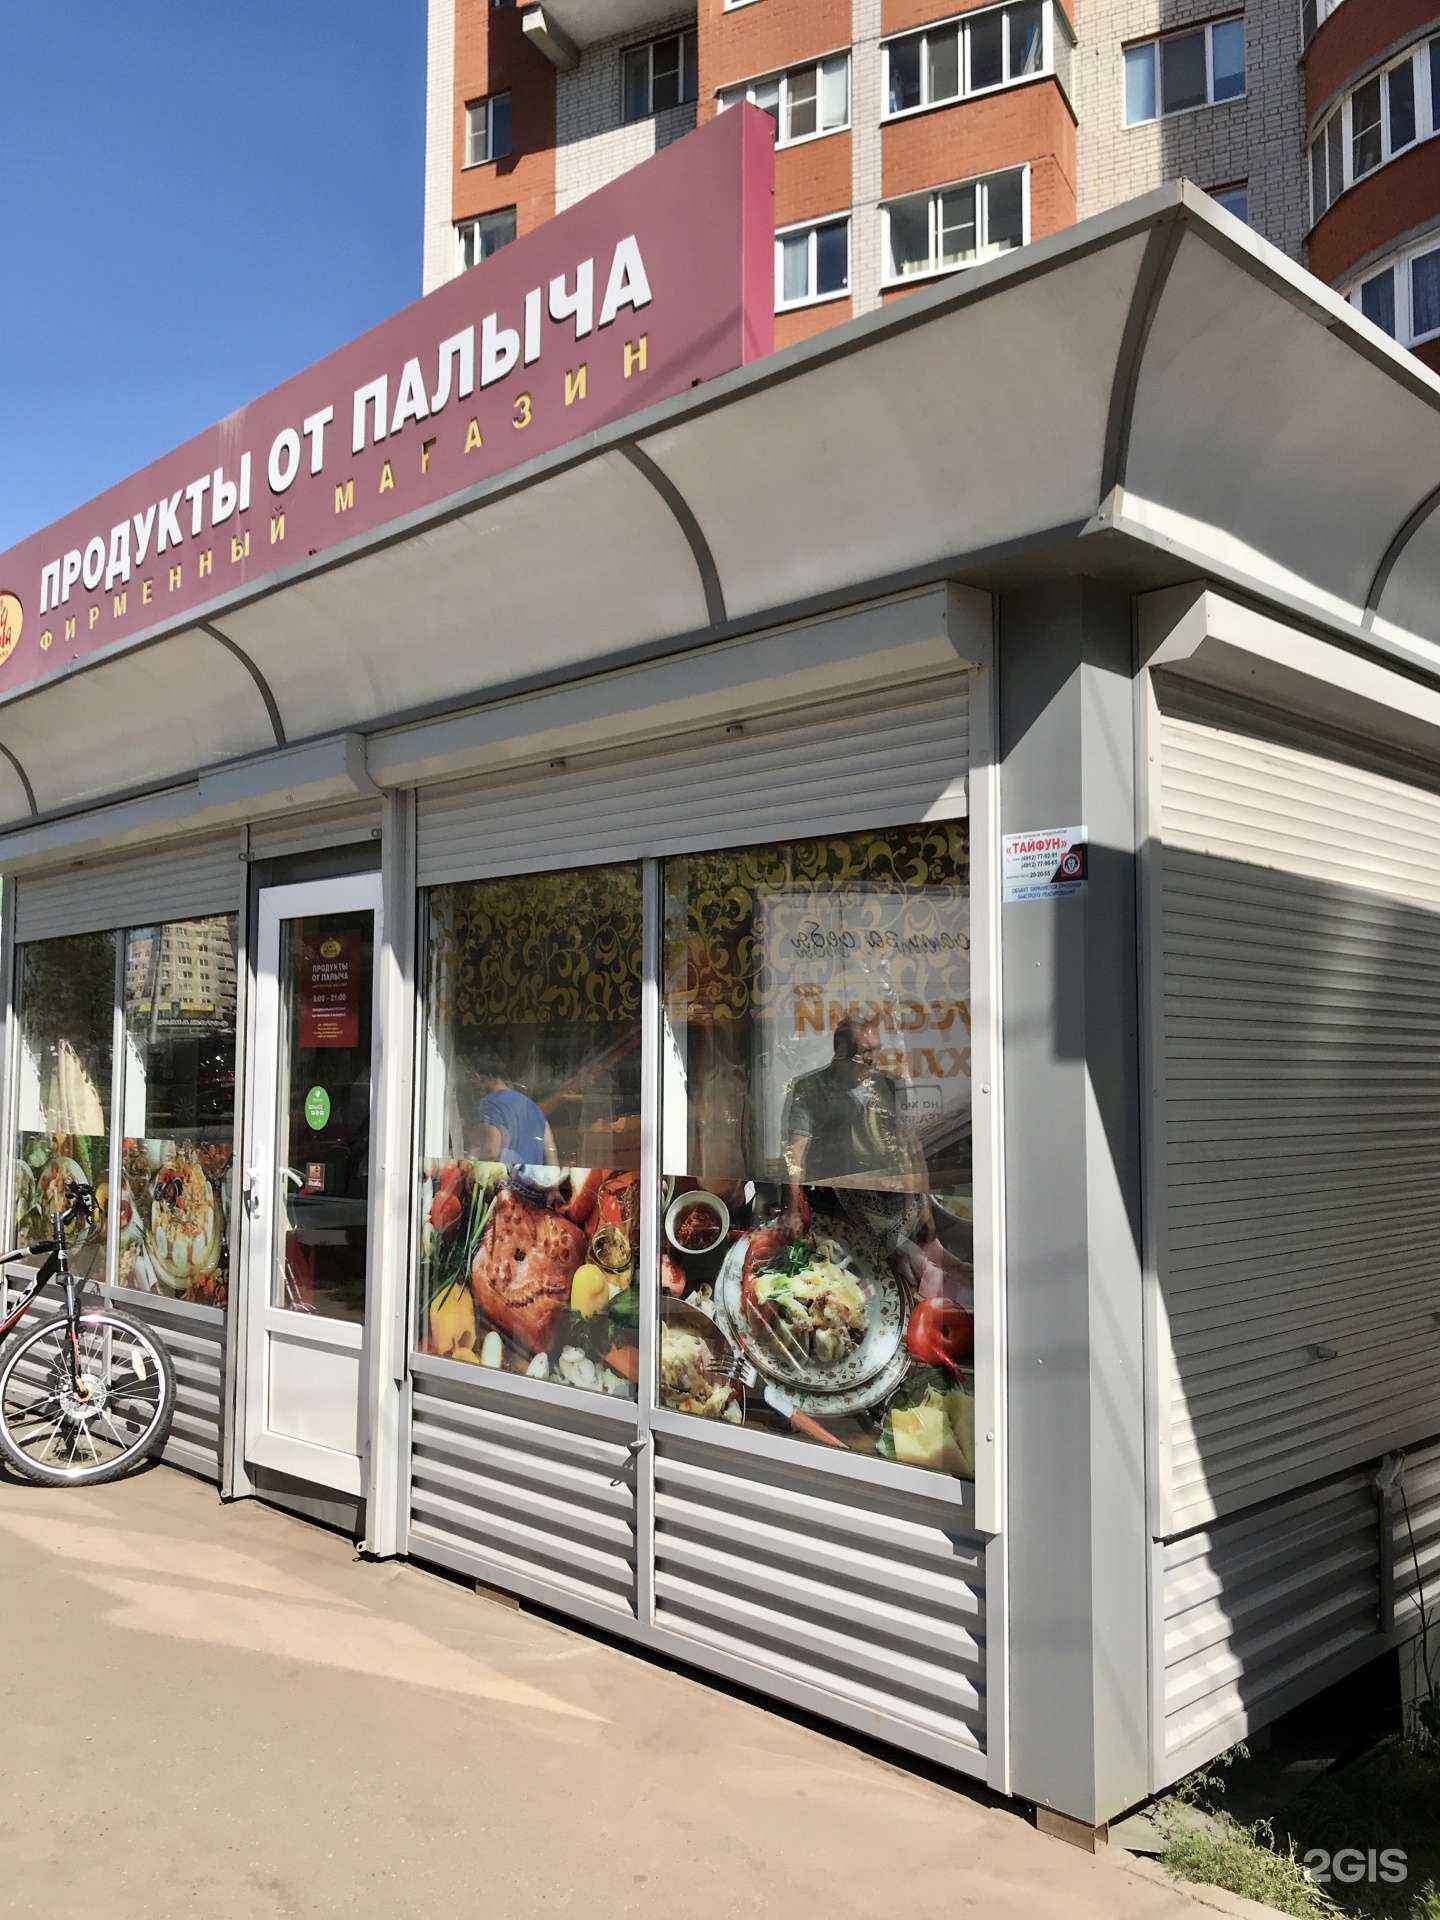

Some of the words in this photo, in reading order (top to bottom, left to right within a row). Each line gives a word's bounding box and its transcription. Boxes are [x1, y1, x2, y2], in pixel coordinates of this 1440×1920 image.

[40, 452, 253, 615] ПРОДУКТЫ
[268, 404, 334, 493] ОТ
[352, 235, 653, 454] ПАЛЫЧА
[40, 507, 286, 652] ФИРМЕННЫЙ
[335, 334, 650, 514] МАГАЗИН
[1006, 837, 1067, 855] «ТАЙФУН»
[312, 963, 348, 973] ПРОДУКТЫ
